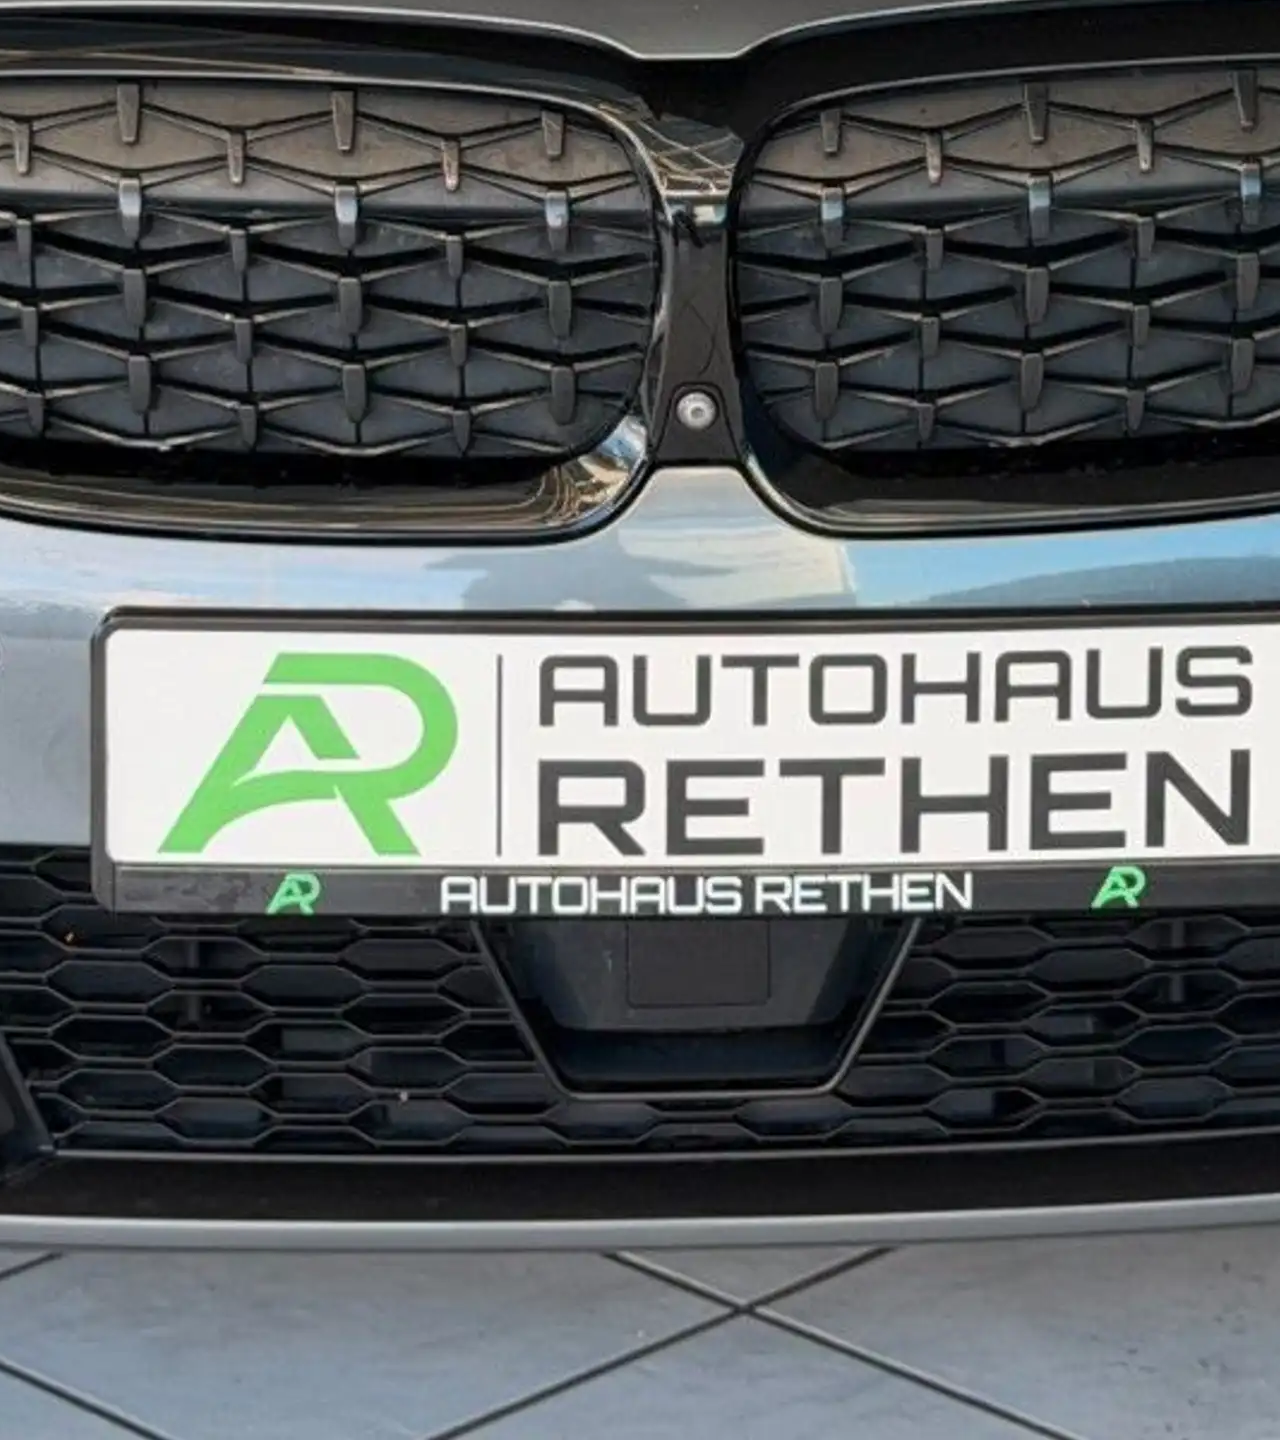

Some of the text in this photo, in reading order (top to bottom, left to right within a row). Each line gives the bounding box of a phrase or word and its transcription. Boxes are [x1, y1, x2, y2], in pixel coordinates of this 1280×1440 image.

[539, 646, 1253, 727] AUTOHAUS
[538, 750, 1252, 856] RETHEN
[440, 871, 973, 915] AUTOHAUS RETHEN
